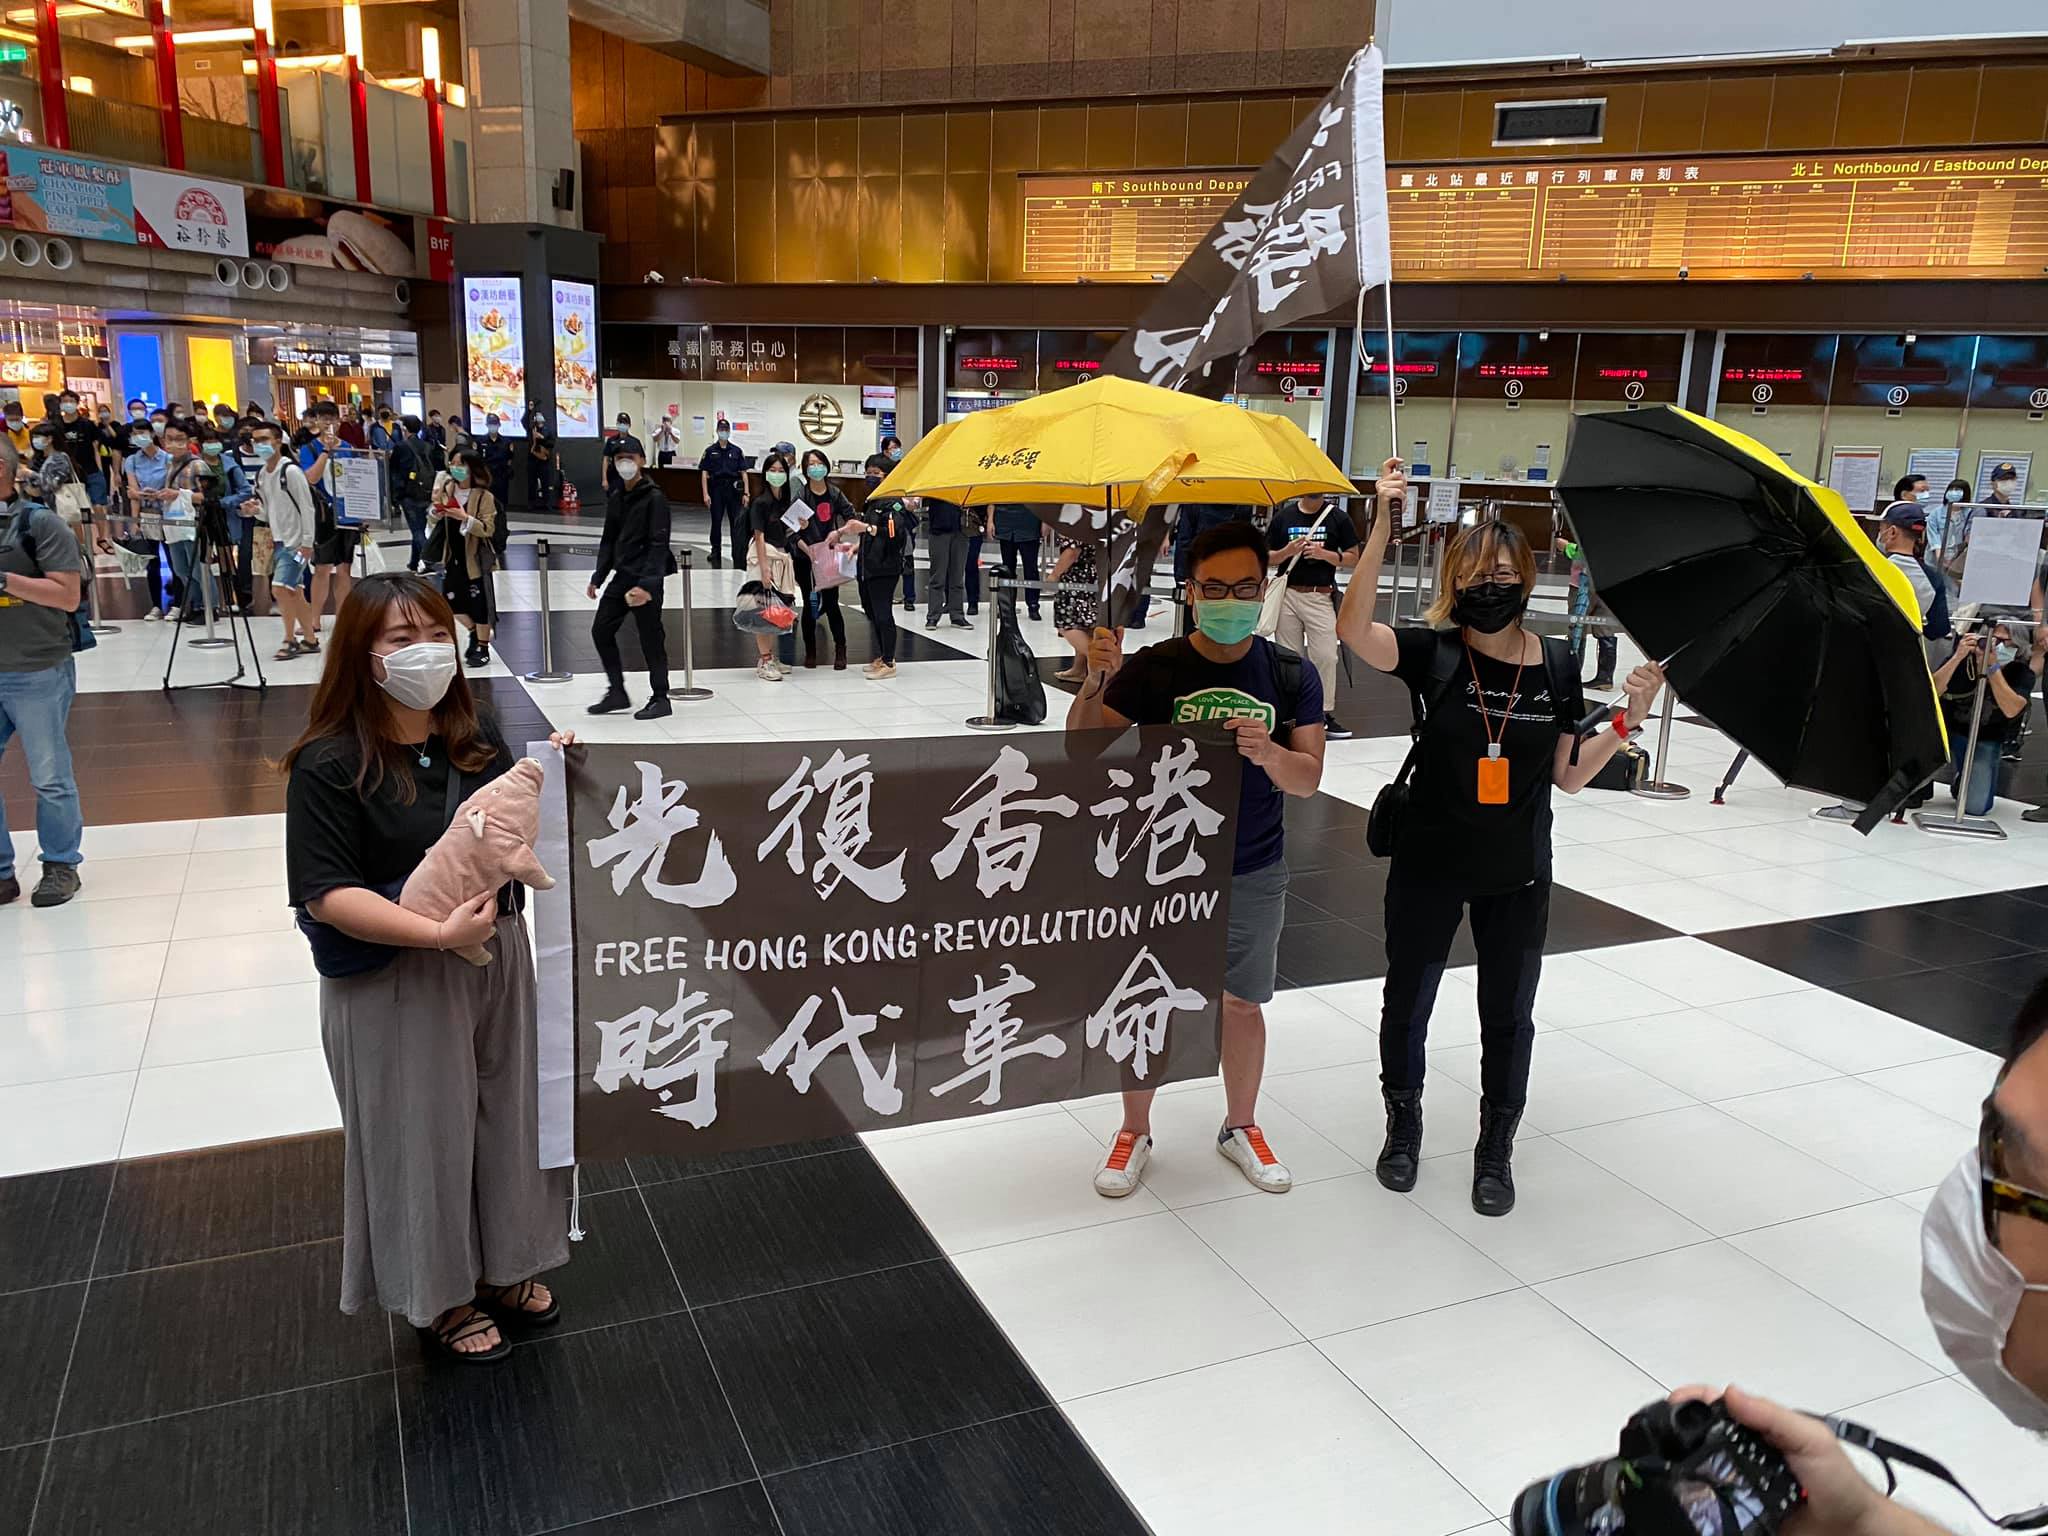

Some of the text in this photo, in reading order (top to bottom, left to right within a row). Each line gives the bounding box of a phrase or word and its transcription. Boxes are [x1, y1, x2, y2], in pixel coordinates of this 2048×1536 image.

[1791, 162, 1824, 177] 北上
[1833, 160, 1920, 175] Northbound
[1934, 157, 2016, 171] Eastbound
[43, 177, 105, 194] CHAMPION
[1400, 166, 1700, 188] 臺北站最近開行列車時刻表
[1092, 181, 1116, 194] 南下
[1122, 179, 1203, 192] Southbound
[44, 190, 106, 209] PINEAPPLE
[46, 204, 75, 217] CAKE
[138, 232, 153, 244] B1
[430, 236, 450, 251] B1F
[671, 358, 777, 372] TRA Information
[586, 738, 1225, 908] 光復香港
[594, 936, 689, 976] FREE
[704, 934, 807, 971] HONG
[1150, 890, 1219, 928] NOW
[593, 945, 1208, 1130] 時代革命
